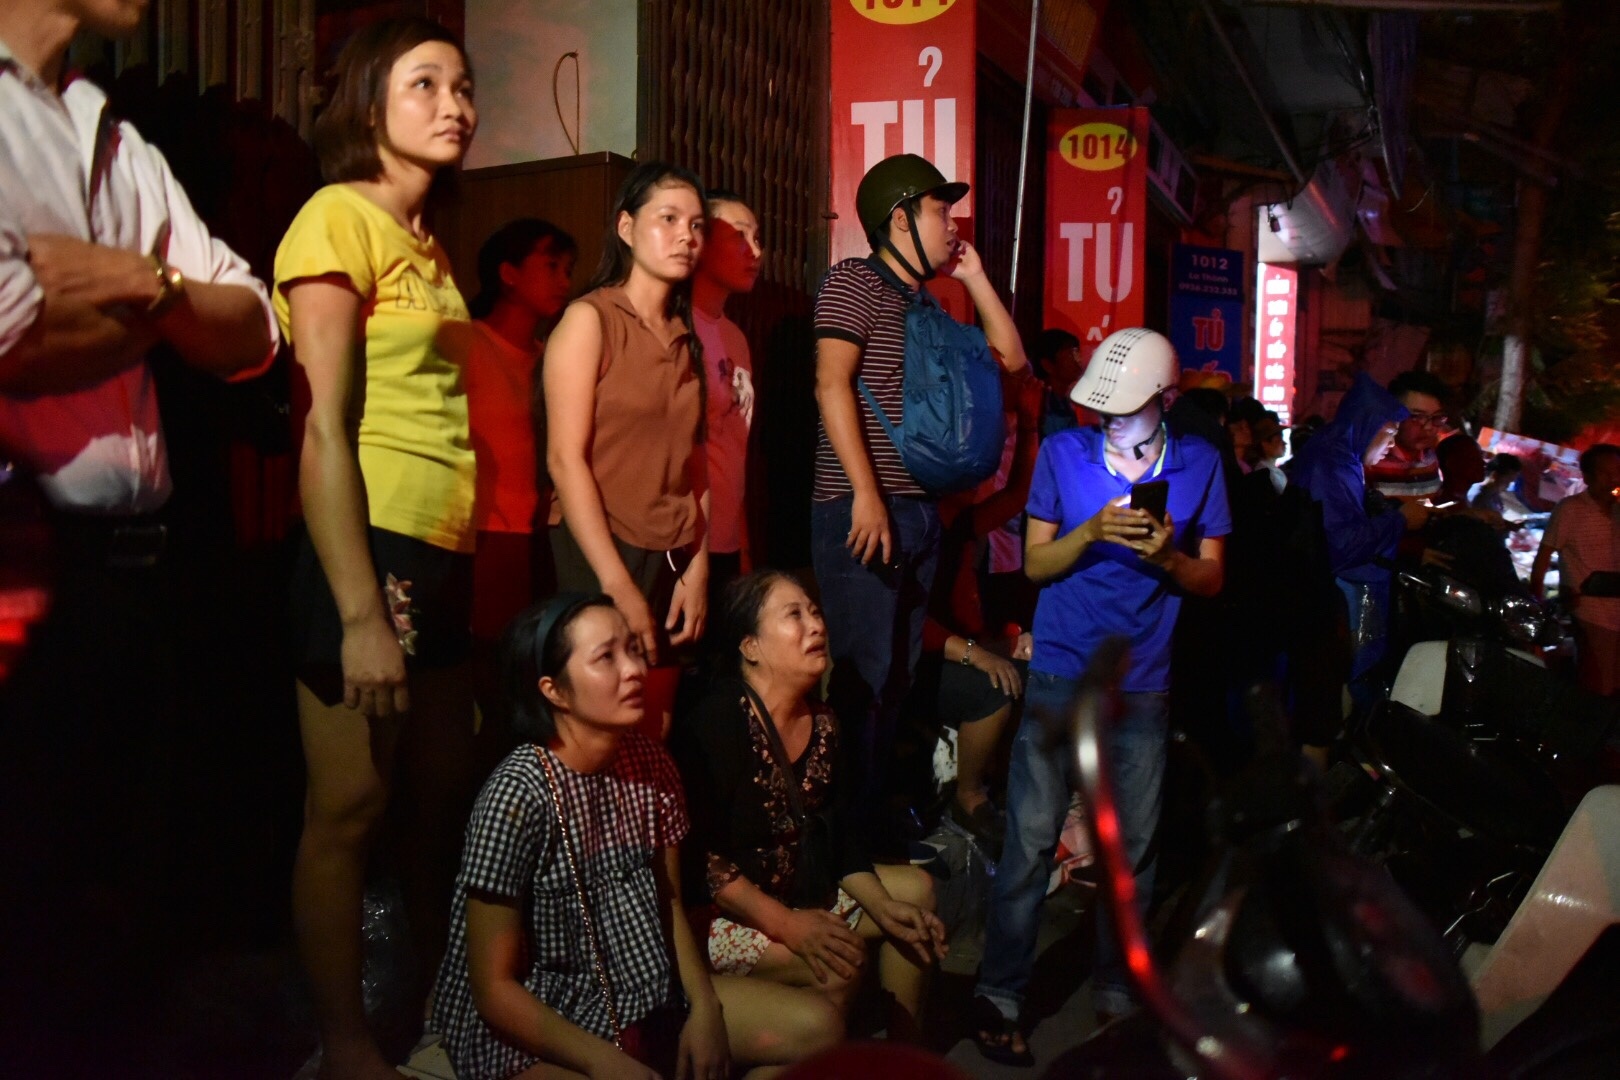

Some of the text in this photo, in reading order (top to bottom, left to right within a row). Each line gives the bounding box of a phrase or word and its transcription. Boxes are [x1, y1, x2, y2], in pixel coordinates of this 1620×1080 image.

[1067, 134, 1130, 160] 1014
[1060, 186, 1133, 303] TỦ
[1191, 254, 1228, 271] 1012
[1192, 308, 1225, 351] TỦ
